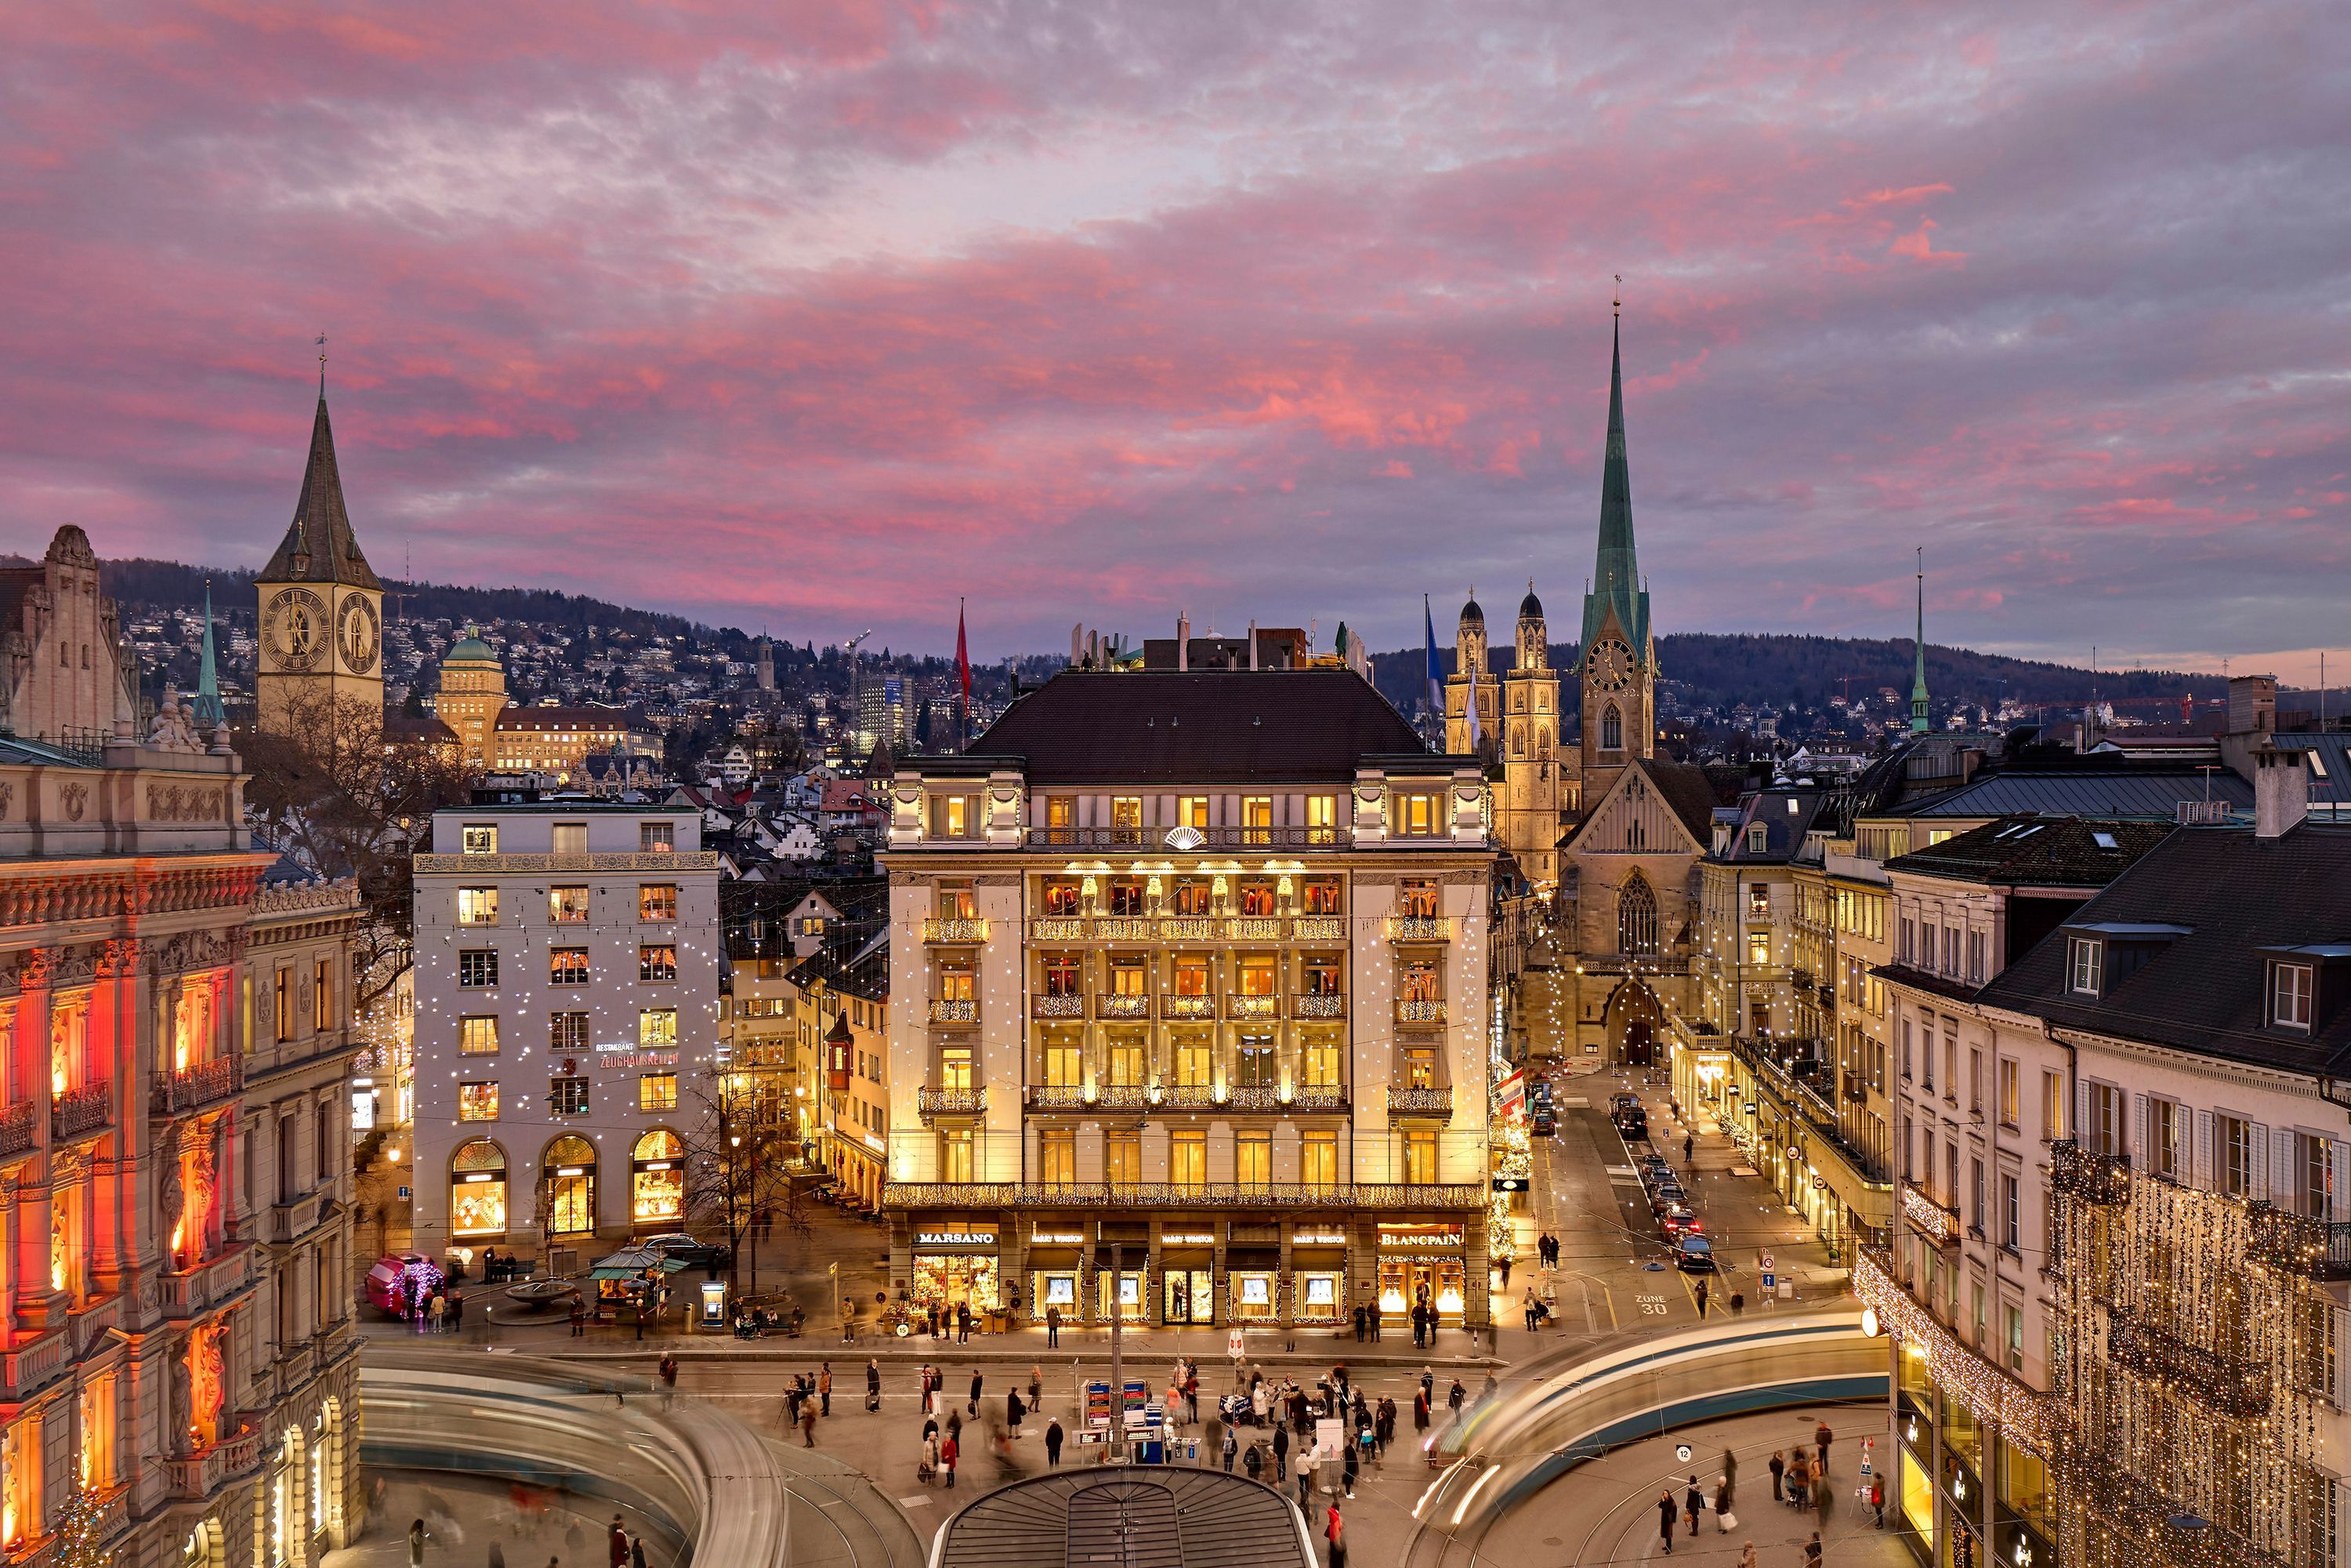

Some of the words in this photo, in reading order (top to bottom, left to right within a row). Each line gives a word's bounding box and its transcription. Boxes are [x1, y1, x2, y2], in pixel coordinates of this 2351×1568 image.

[596, 1043, 634, 1052] RESTAURANT
[919, 1233, 994, 1244] MARSANO
[1031, 1234, 1052, 1244] HARRY
[1054, 1234, 1083, 1244] WINSTON
[1162, 1234, 1183, 1244] HARRY
[1184, 1234, 1214, 1244] WINSTON
[1293, 1234, 1315, 1244] HARRY
[1316, 1234, 1346, 1244] WINSTON
[1381, 1233, 1461, 1246] BLANCPAIN
[1635, 1295, 1667, 1303] ZONE
[1641, 1304, 1668, 1315] 30
